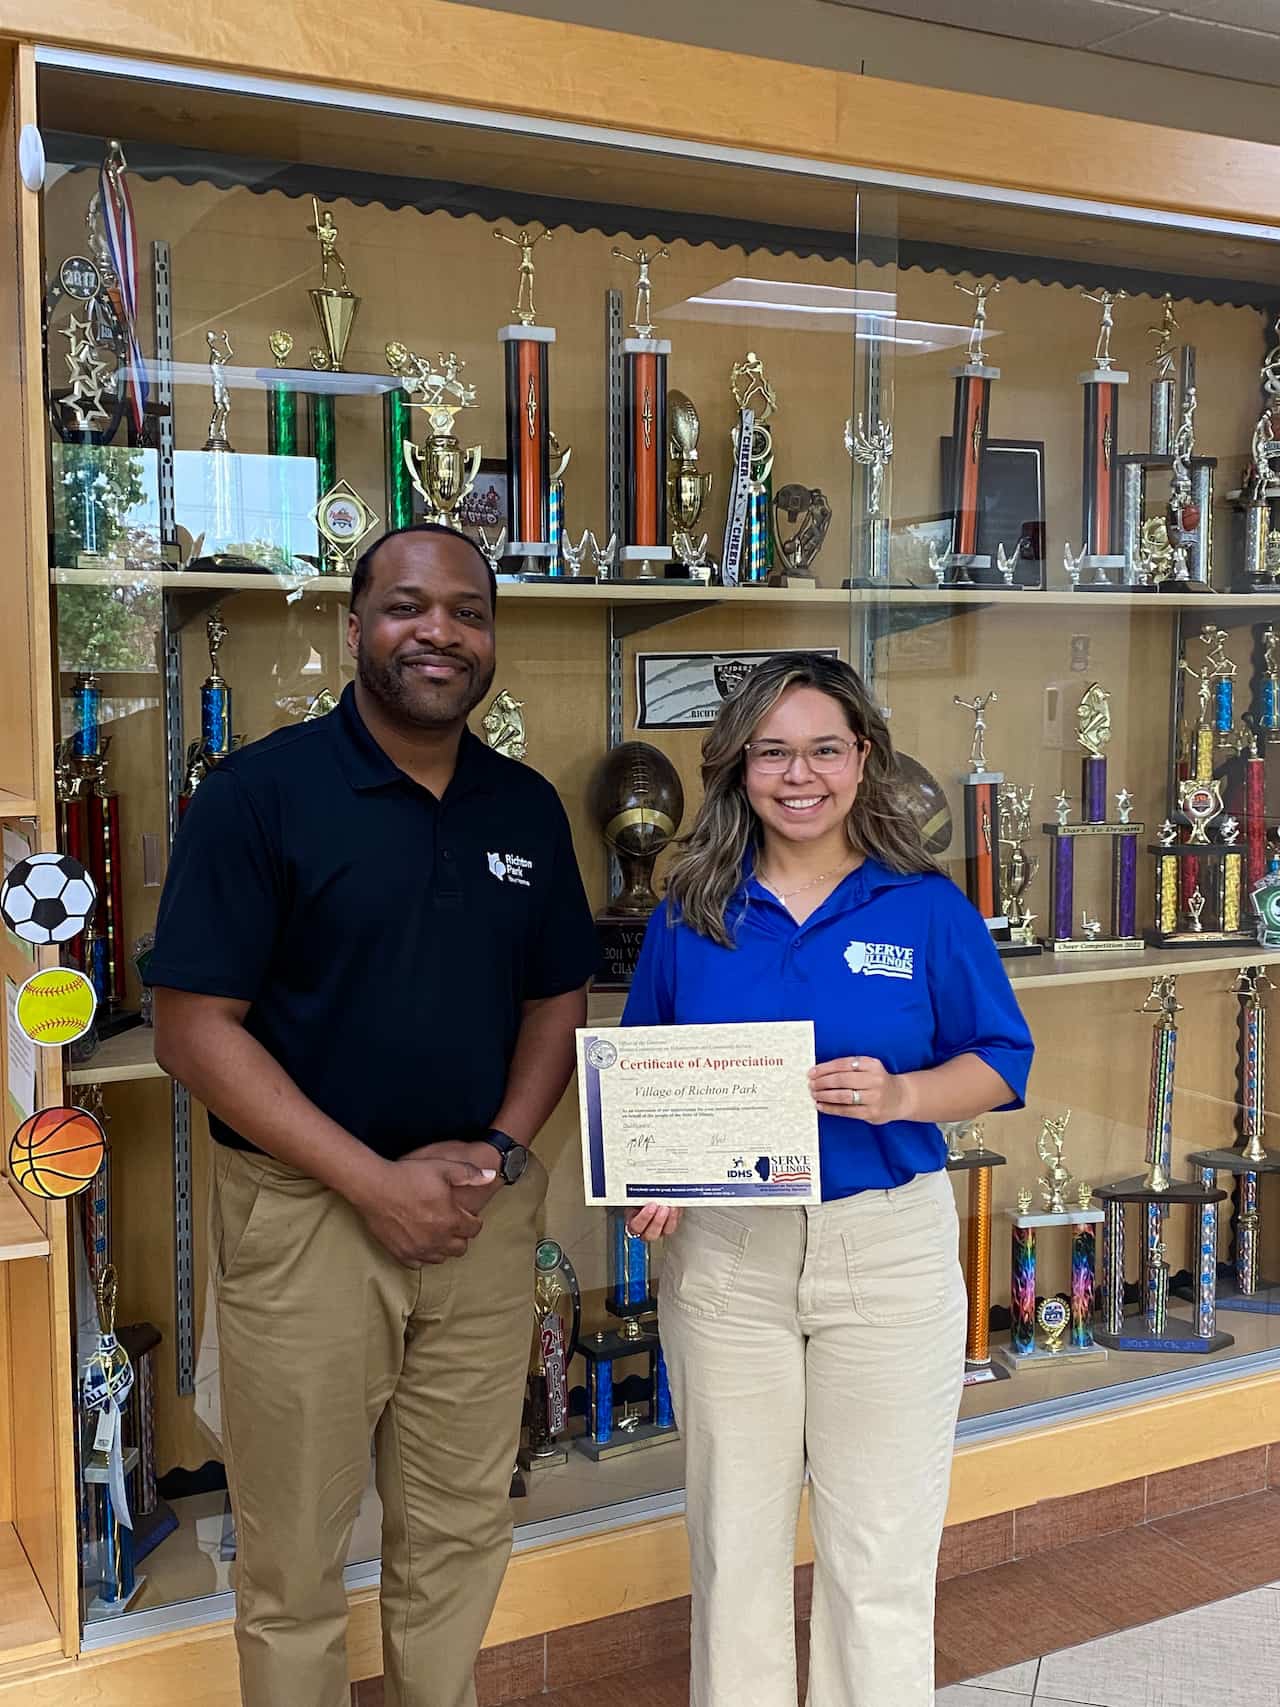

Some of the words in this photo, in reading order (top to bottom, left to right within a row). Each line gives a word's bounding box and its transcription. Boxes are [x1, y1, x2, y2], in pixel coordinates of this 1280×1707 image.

[740, 435, 750, 477] CHEER
[728, 527, 741, 566] CHEER
[865, 943, 914, 960] SERVE
[865, 954, 914, 970] ILLINOIS
[620, 1057, 685, 1071] Certificate
[688, 1057, 701, 1069] of
[703, 1055, 784, 1071] Appreciation
[634, 1086, 672, 1098] Village
[674, 1085, 686, 1098] of
[688, 1084, 729, 1096] Richton
[731, 1083, 758, 1096] Park
[770, 1155, 811, 1165] SERVE
[727, 1169, 753, 1178] IDHS
